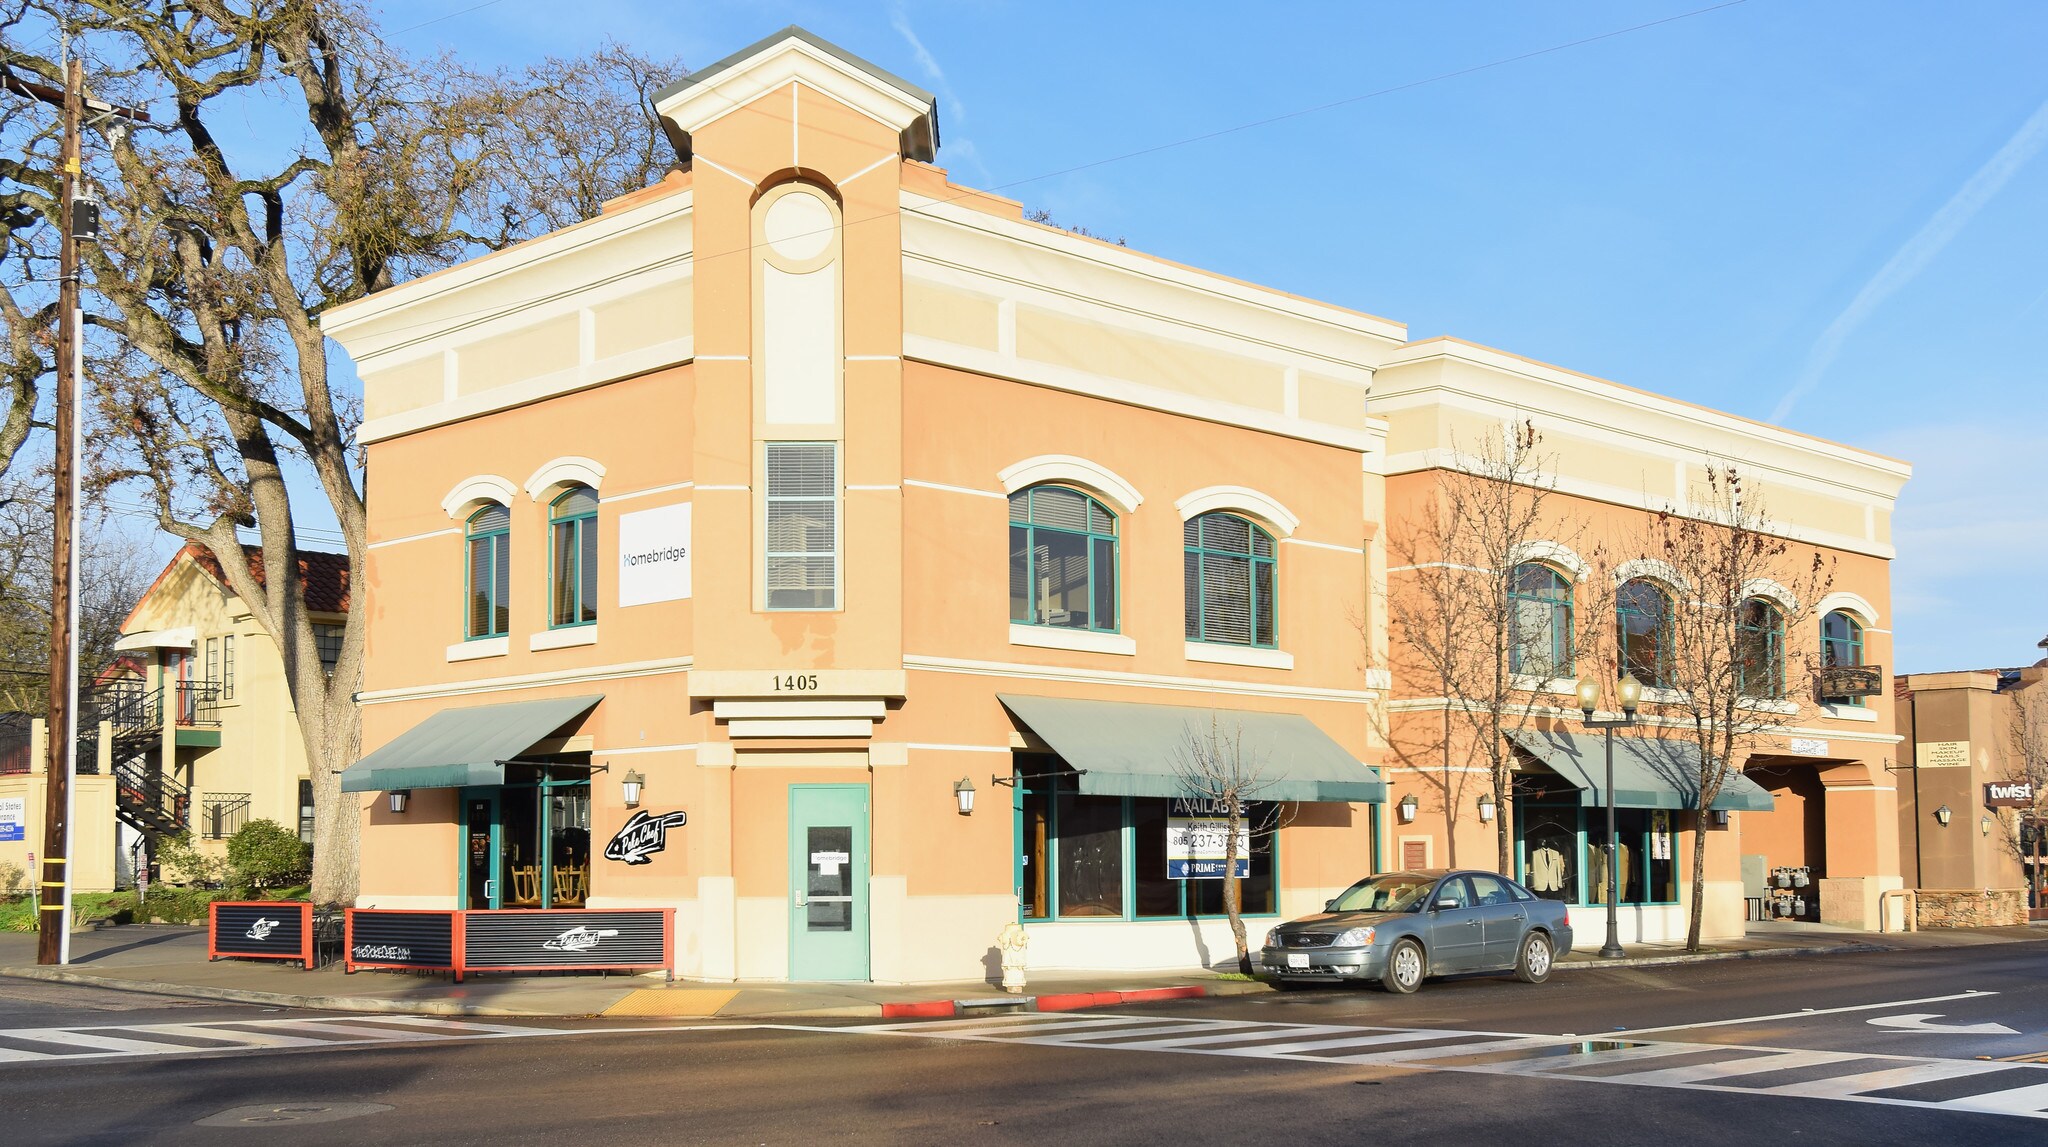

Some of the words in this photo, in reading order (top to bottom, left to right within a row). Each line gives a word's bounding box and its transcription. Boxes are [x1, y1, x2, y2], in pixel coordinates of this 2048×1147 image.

[623, 546, 686, 567] Homebridge
[772, 674, 818, 691] 1405
[1990, 783, 2032, 799] twist
[1173, 797, 1245, 814] AVAILABE
[1187, 822, 1208, 832] Keith
[1173, 836, 1188, 846] 805
[1191, 863, 1216, 873] PRIME
